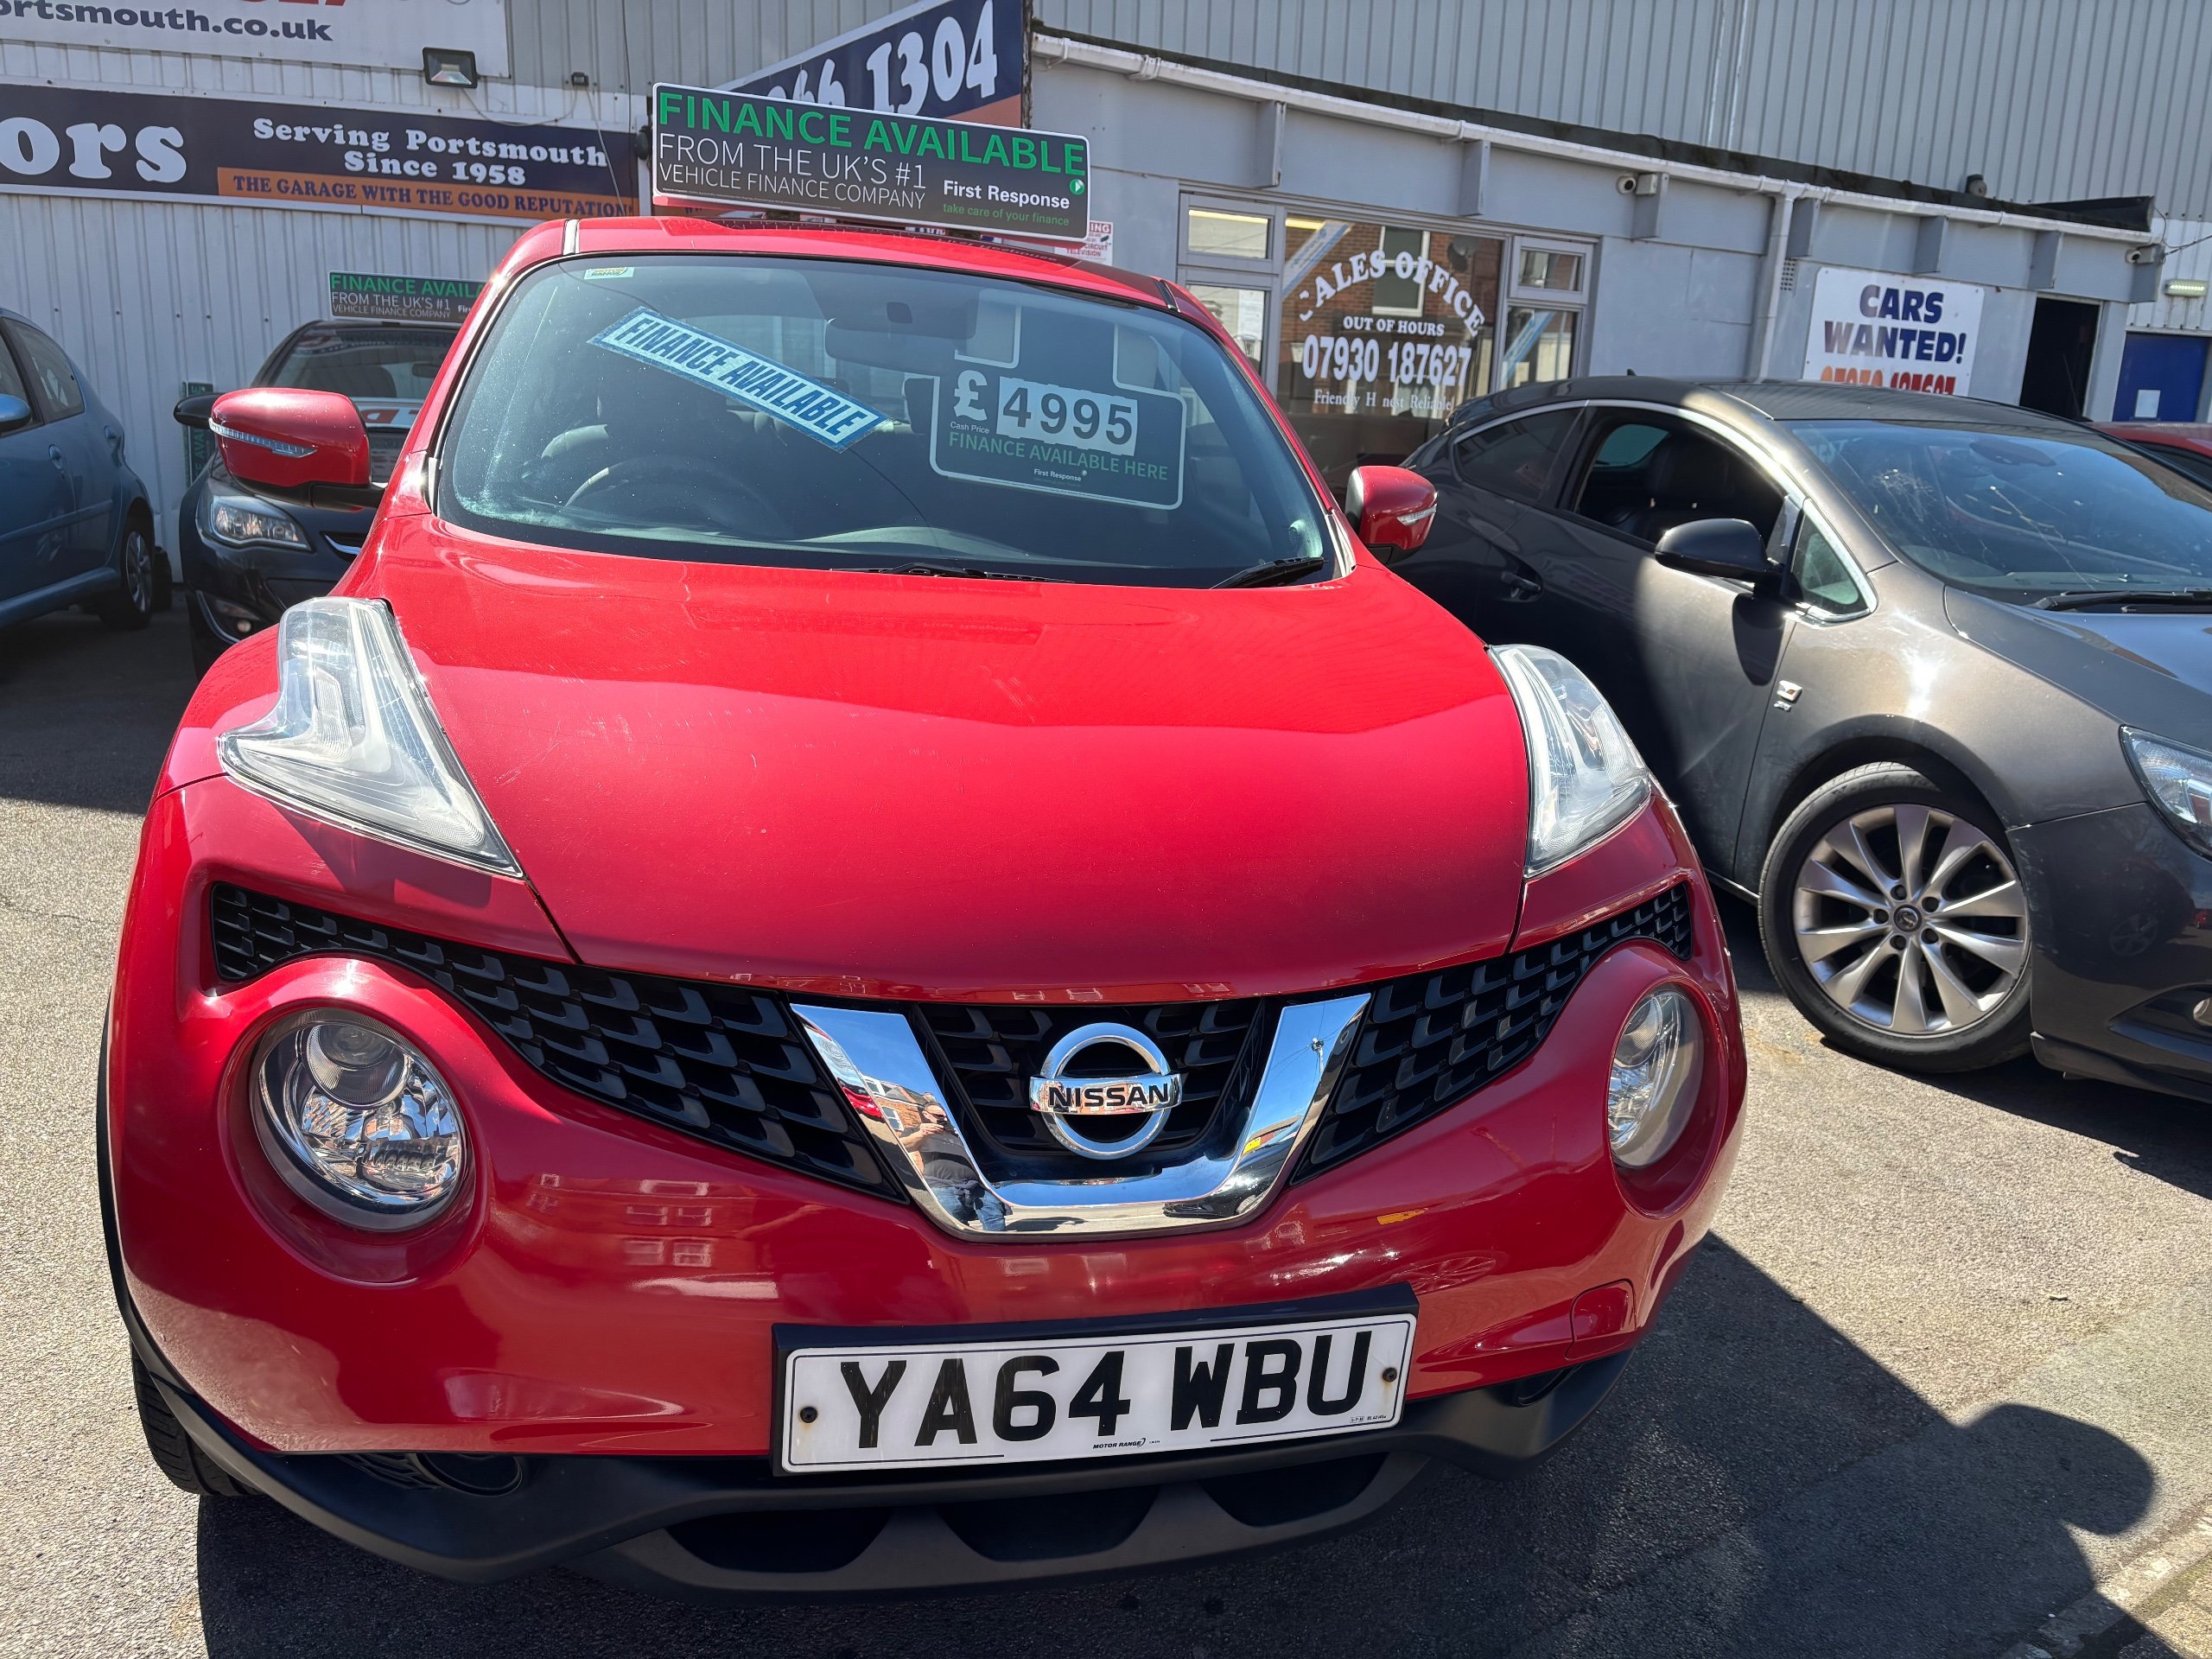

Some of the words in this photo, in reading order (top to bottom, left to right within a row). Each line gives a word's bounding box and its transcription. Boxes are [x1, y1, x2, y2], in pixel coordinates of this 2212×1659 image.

[867, 0, 998, 117] 1304
[0, 117, 187, 183] ors
[253, 118, 391, 152] Serving
[405, 129, 608, 168] Portsmouth
[659, 92, 853, 148] FINANCE
[865, 119, 1086, 176] AVAILABLE
[344, 150, 438, 179] Since
[452, 161, 526, 186] 1958
[659, 134, 743, 169] FROM
[753, 143, 811, 176] THE
[823, 154, 887, 185] UK'S
[895, 162, 927, 189] #1
[233, 175, 271, 194] THE
[276, 178, 357, 200] GARAGE
[361, 185, 412, 204] WITH
[416, 188, 454, 207] THE
[458, 191, 510, 210] GOOD
[659, 162, 741, 190] VEHICLE
[747, 174, 829, 200] FINANCE
[835, 182, 925, 210] COMPANY
[944, 180, 982, 200] First
[988, 185, 1070, 210] Response
[943, 203, 965, 214] take
[967, 207, 989, 218] care
[993, 207, 1004, 219] of
[1005, 210, 1031, 223] your
[1032, 212, 1070, 226] finance
[1090, 222, 1111, 232] ING
[331, 274, 416, 295] FINANCE
[422, 281, 486, 299] AVAIL
[331, 292, 370, 306] FROM
[372, 294, 399, 308] THE
[436, 298, 451, 311] #1
[1394, 251, 1486, 338] OFFICE
[1859, 284, 1944, 324] CARS
[332, 303, 368, 315] VEHICLE
[371, 306, 408, 317] FINANCE
[410, 308, 451, 319] COMPANY
[1344, 315, 1372, 332] OUT
[1376, 317, 1395, 333] OF
[1398, 321, 1445, 337] HOURS
[1302, 334, 1380, 382] 07930
[1387, 341, 1472, 387] 187627
[1824, 321, 1967, 365] WANTED!
[613, 317, 740, 374] FINANCE
[718, 359, 865, 435] AVAILABLE
[950, 421, 969, 432] Cash
[971, 424, 990, 435] Price
[953, 370, 988, 422] £
[1002, 386, 1133, 445] 4995
[950, 432, 1026, 458] FINANCE
[1029, 445, 1120, 474] AVAILABLE
[1124, 460, 1168, 480] HERE
[1033, 468, 1048, 477] First
[1051, 471, 1082, 482] Response
[1049, 1083, 1168, 1107] NISSAN
[841, 1351, 1131, 1449] YA64
[1170, 1332, 1373, 1432] WBU
